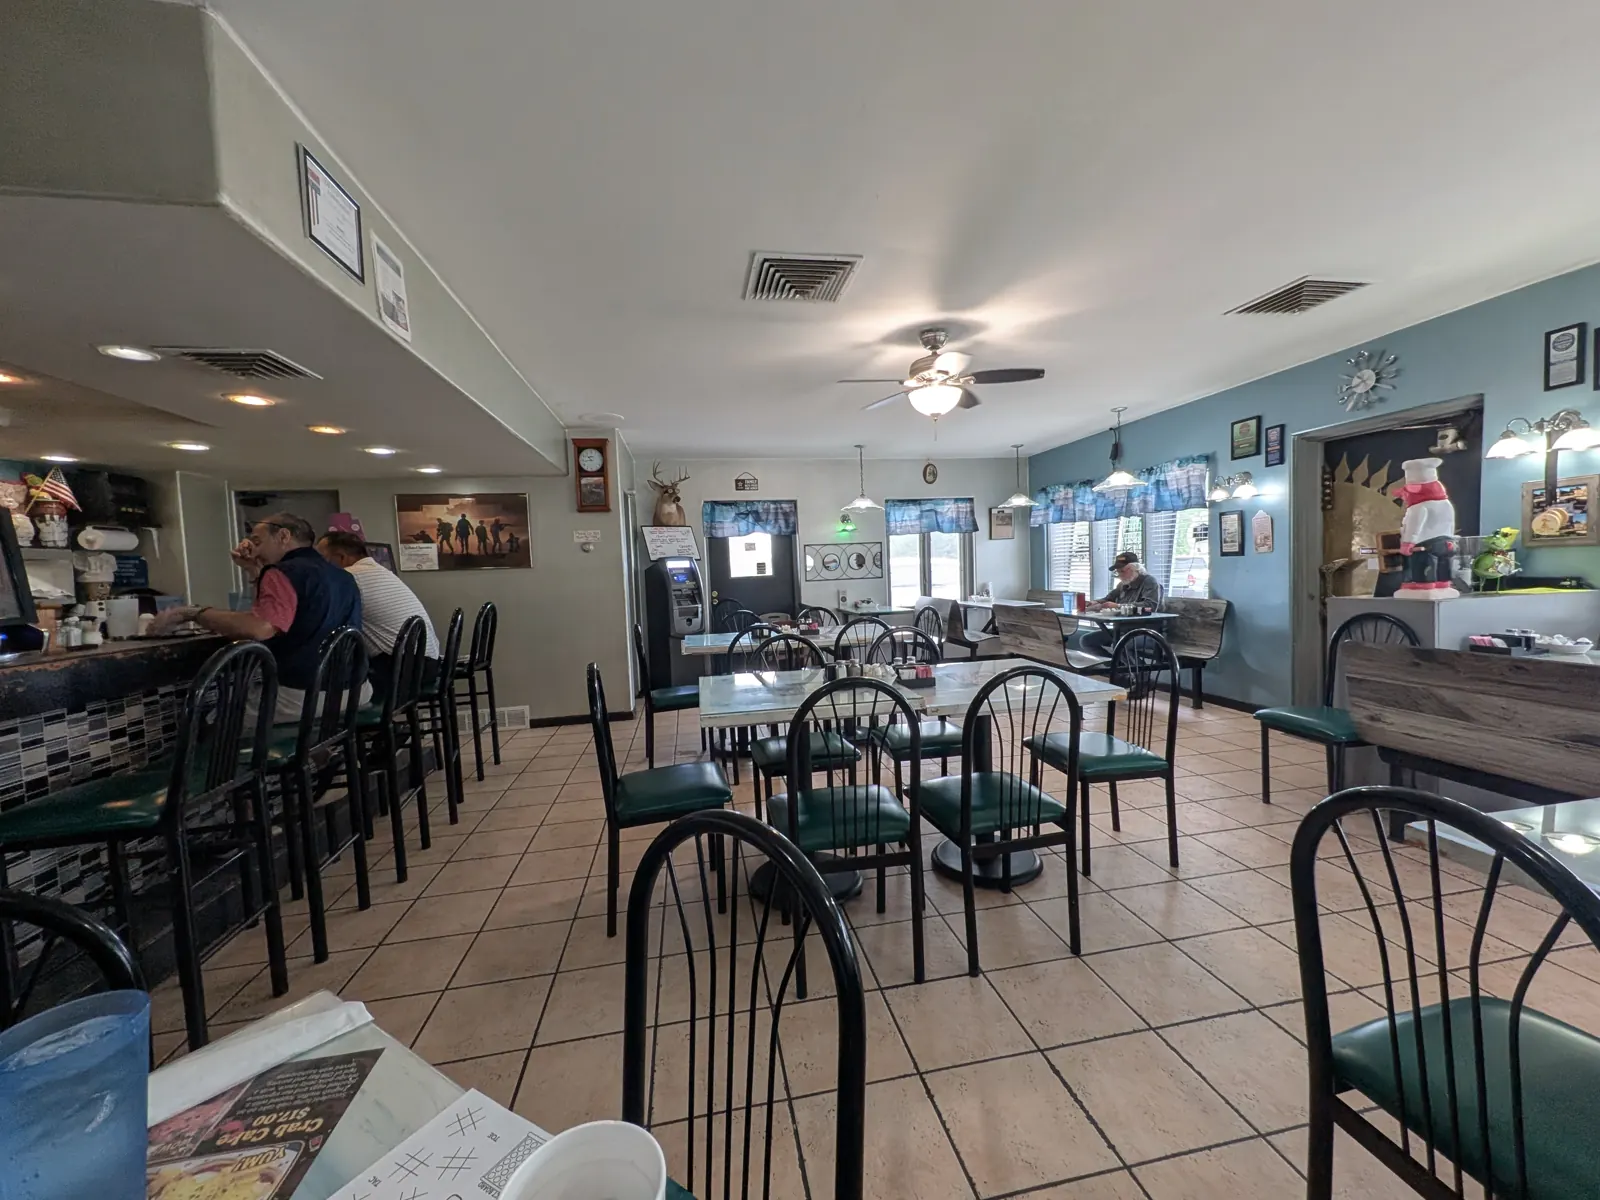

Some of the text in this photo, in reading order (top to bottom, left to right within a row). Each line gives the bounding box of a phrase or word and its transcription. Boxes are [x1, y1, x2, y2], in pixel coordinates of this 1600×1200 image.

[253, 1107, 310, 1125] $17.00
[275, 1118, 324, 1138] Crab
[216, 1131, 268, 1146] Cake
[234, 1146, 287, 1172] YUM!
[368, 1176, 382, 1187] TAC
